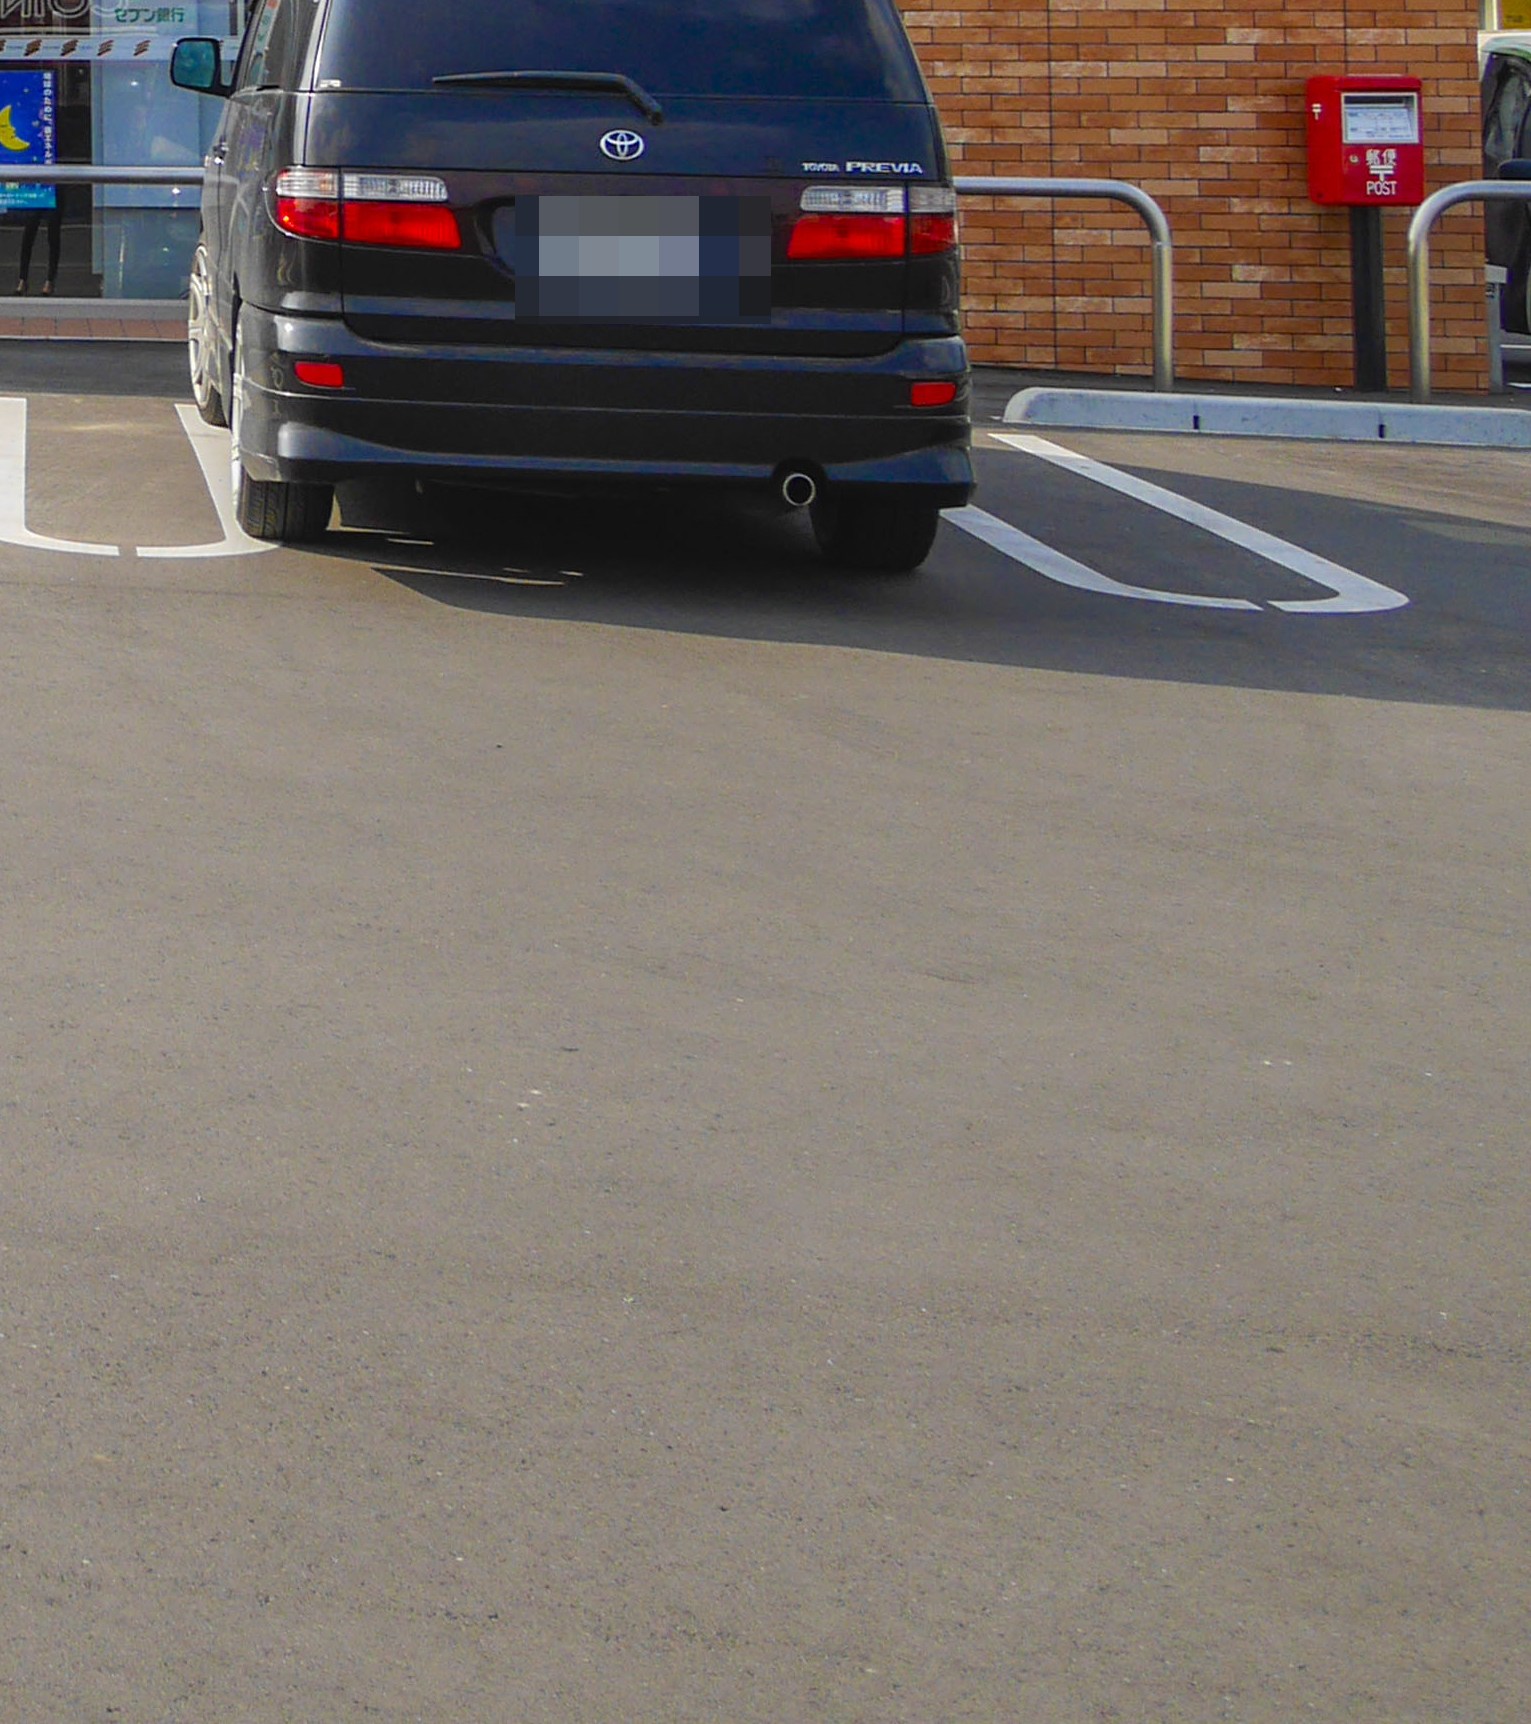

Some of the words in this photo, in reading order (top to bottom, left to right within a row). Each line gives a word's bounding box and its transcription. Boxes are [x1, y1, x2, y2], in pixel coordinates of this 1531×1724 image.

[115, 7, 185, 23] セブン銀行
[1365, 148, 1397, 166] 郵便
[801, 162, 839, 172] TOYOTA
[845, 161, 923, 174] PREVIA
[1366, 180, 1398, 195] POST
